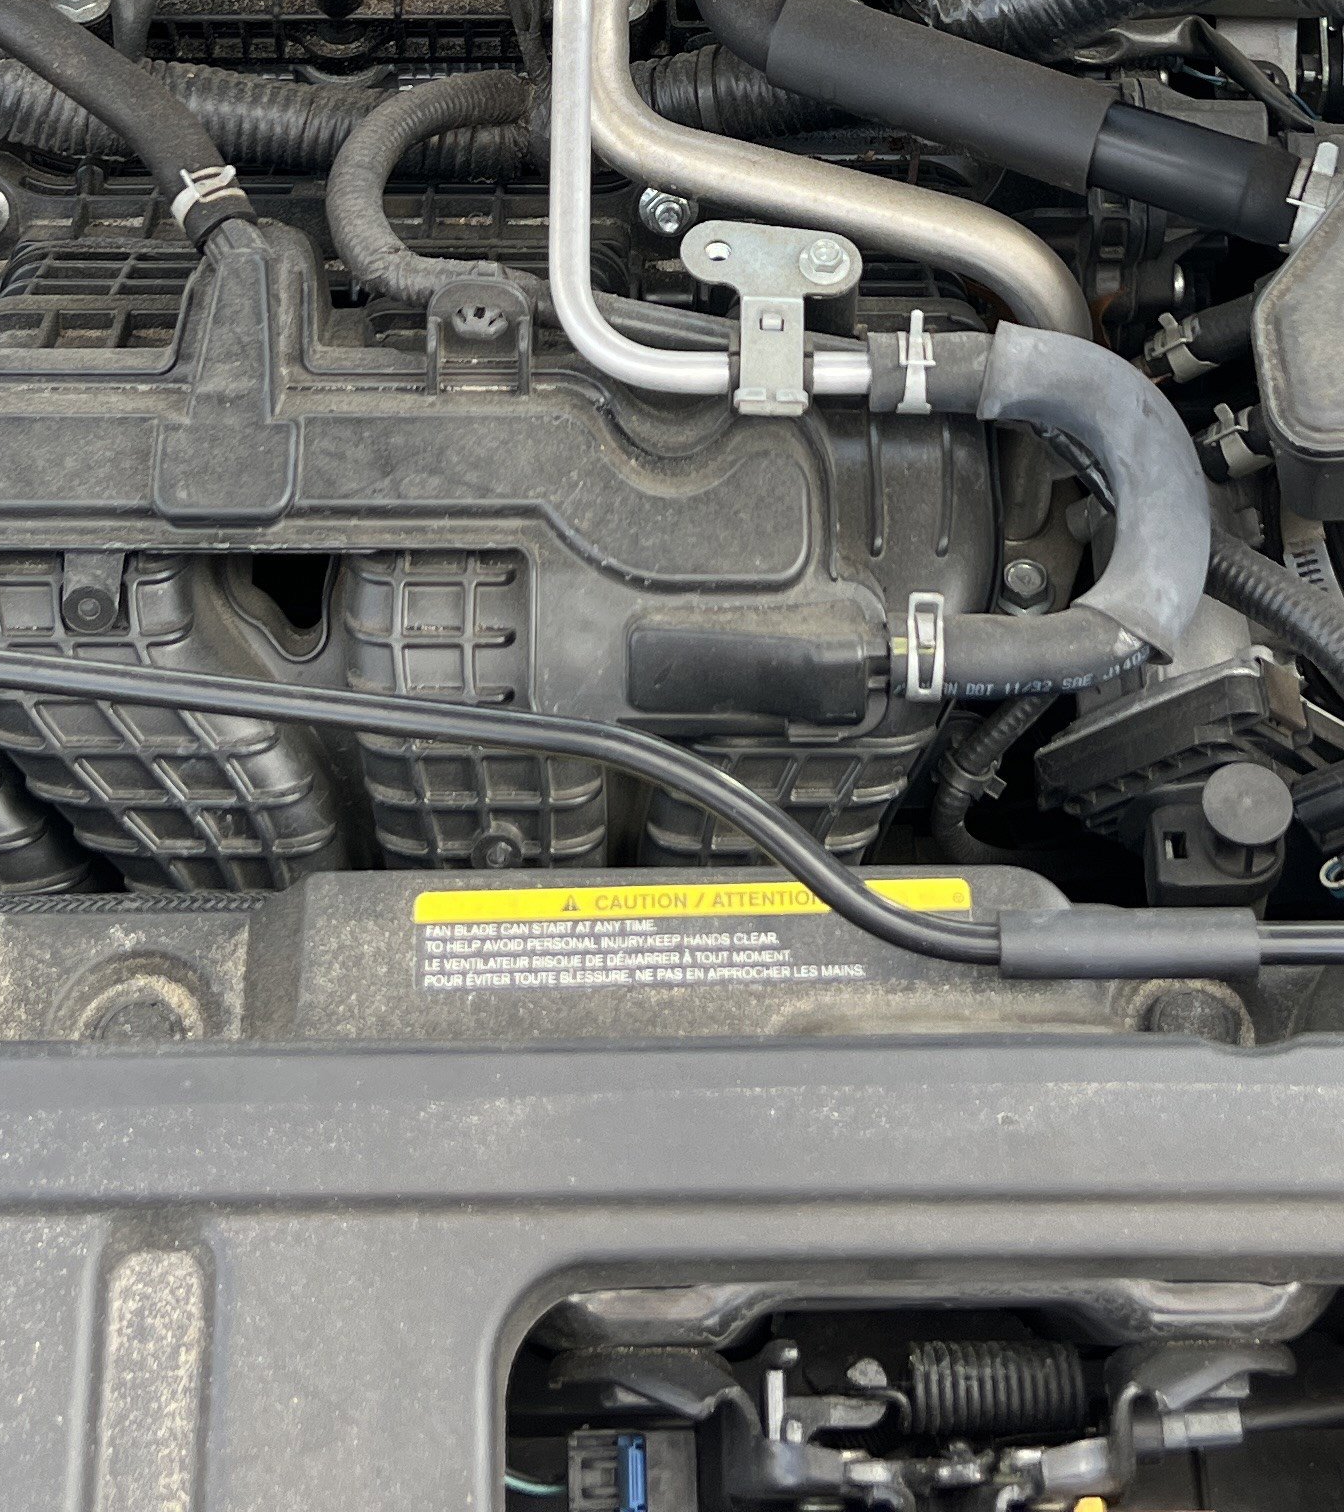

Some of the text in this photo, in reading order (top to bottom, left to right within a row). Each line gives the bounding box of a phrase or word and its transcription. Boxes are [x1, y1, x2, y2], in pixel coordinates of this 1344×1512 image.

[966, 682, 994, 696] DOT
[595, 893, 687, 911] CAUTION
[690, 892, 704, 908] /
[425, 919, 657, 937] FAN BLADE CAN START AT ANY TIME.
[425, 940, 444, 953] TO
[446, 939, 482, 952] HELP
[483, 938, 524, 951] AVOID
[527, 937, 598, 950] PERSONAL
[684, 933, 730, 946] HANDS
[733, 932, 780, 945] CLEAR.
[425, 949, 793, 971] LE VENTILATEUR RISQUE DE DÉMARRER À TOUT MOMENT.
[424, 963, 866, 987] POUR ÉVITER TOUTE BLESSURE, NE PAS EN APPROCHER LES MAINS.
